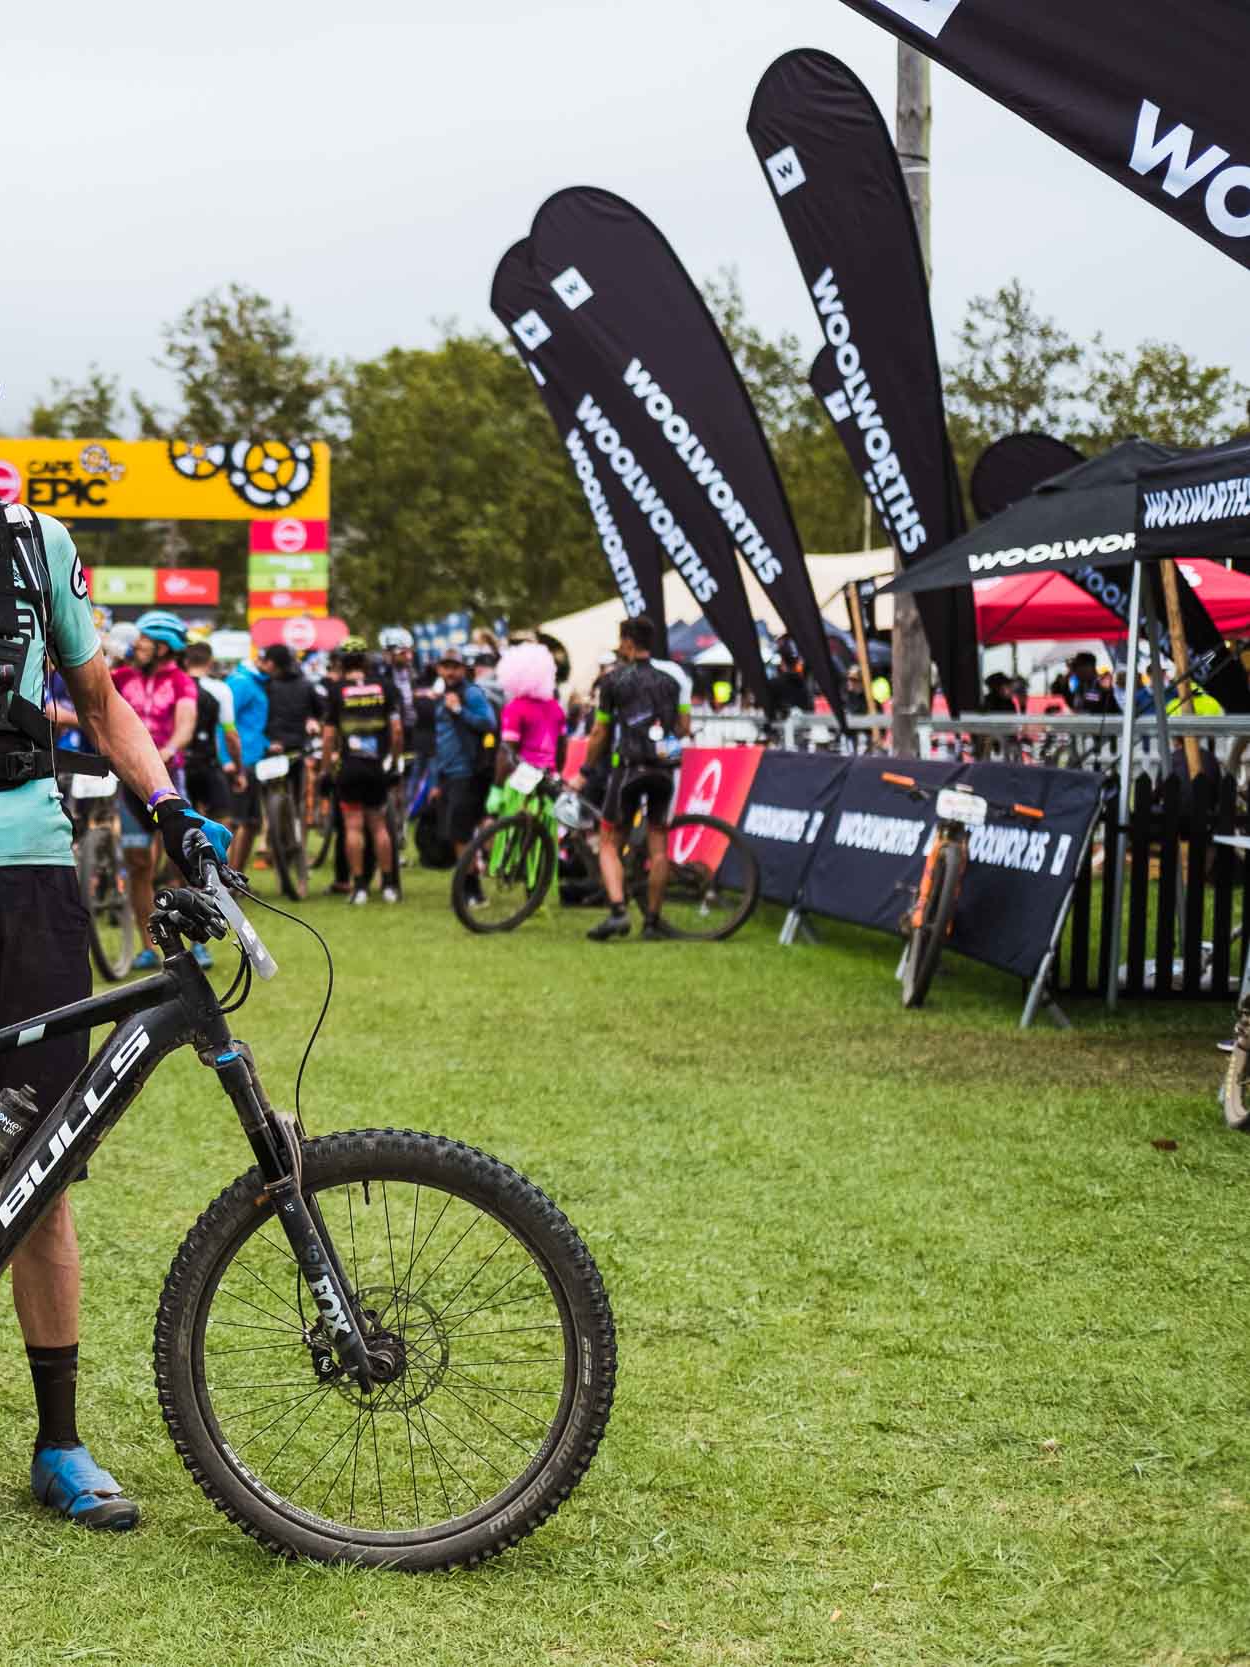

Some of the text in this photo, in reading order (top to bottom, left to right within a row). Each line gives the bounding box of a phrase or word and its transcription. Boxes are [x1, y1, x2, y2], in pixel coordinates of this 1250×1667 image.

[27, 478, 108, 506] EPIC
[576, 394, 718, 603] WOOLWORTHS
[623, 358, 783, 584] WOOLWORTHS
[806, 267, 927, 554] WOOLWORTHS
[566, 429, 646, 619] WOOLWORTHS
[308, 1274, 352, 1337] FOX
